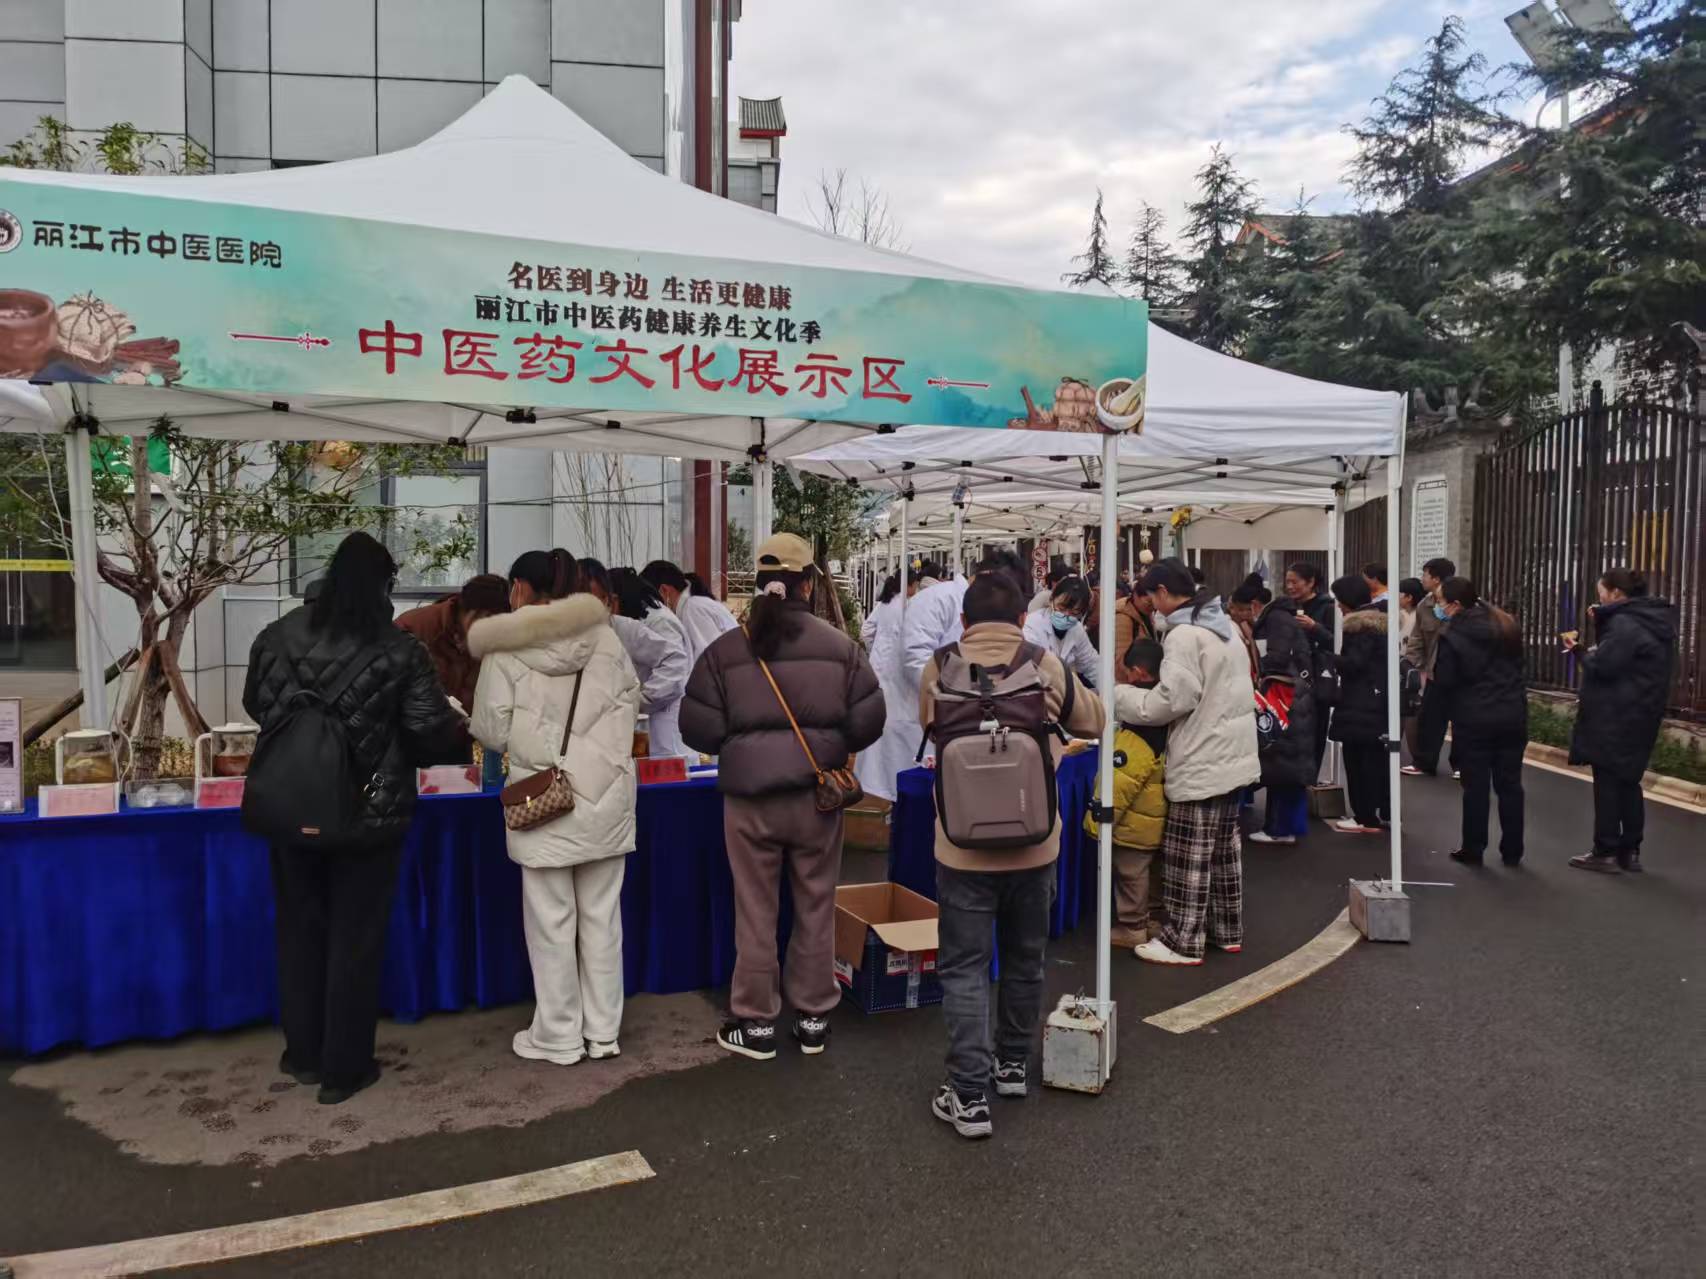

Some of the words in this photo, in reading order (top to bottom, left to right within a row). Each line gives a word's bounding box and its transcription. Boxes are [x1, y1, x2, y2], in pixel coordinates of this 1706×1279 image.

[32, 220, 282, 269] 丽江市中医医院
[508, 261, 649, 300] 名医到身边
[662, 275, 792, 311] 生活更健康
[474, 294, 822, 344] 丽江市中医药健康养生文化季
[358, 319, 913, 404] 中医药文化展示区
[747, 1026, 775, 1036] adida
